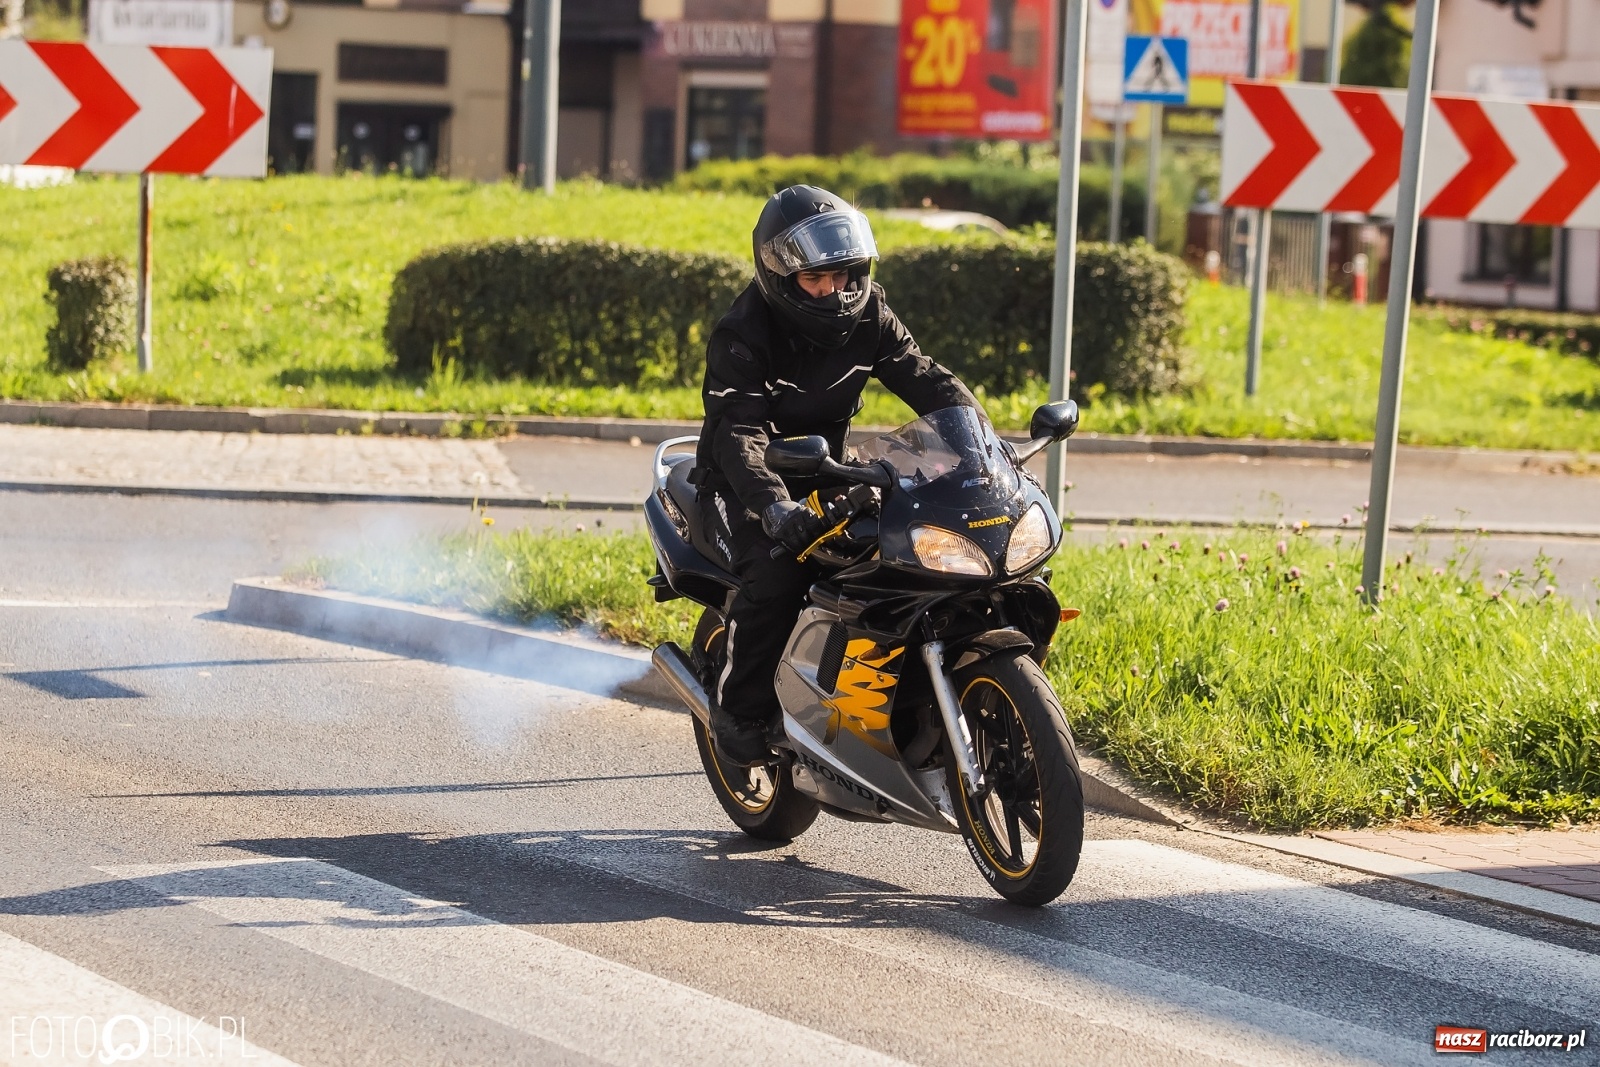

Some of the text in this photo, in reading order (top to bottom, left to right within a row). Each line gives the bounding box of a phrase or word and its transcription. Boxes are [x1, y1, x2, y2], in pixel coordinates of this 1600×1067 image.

[961, 477, 991, 488] NSR
[968, 515, 1012, 529] HONDA
[800, 752, 897, 812] HONDA
[974, 820, 996, 855] HONDA
